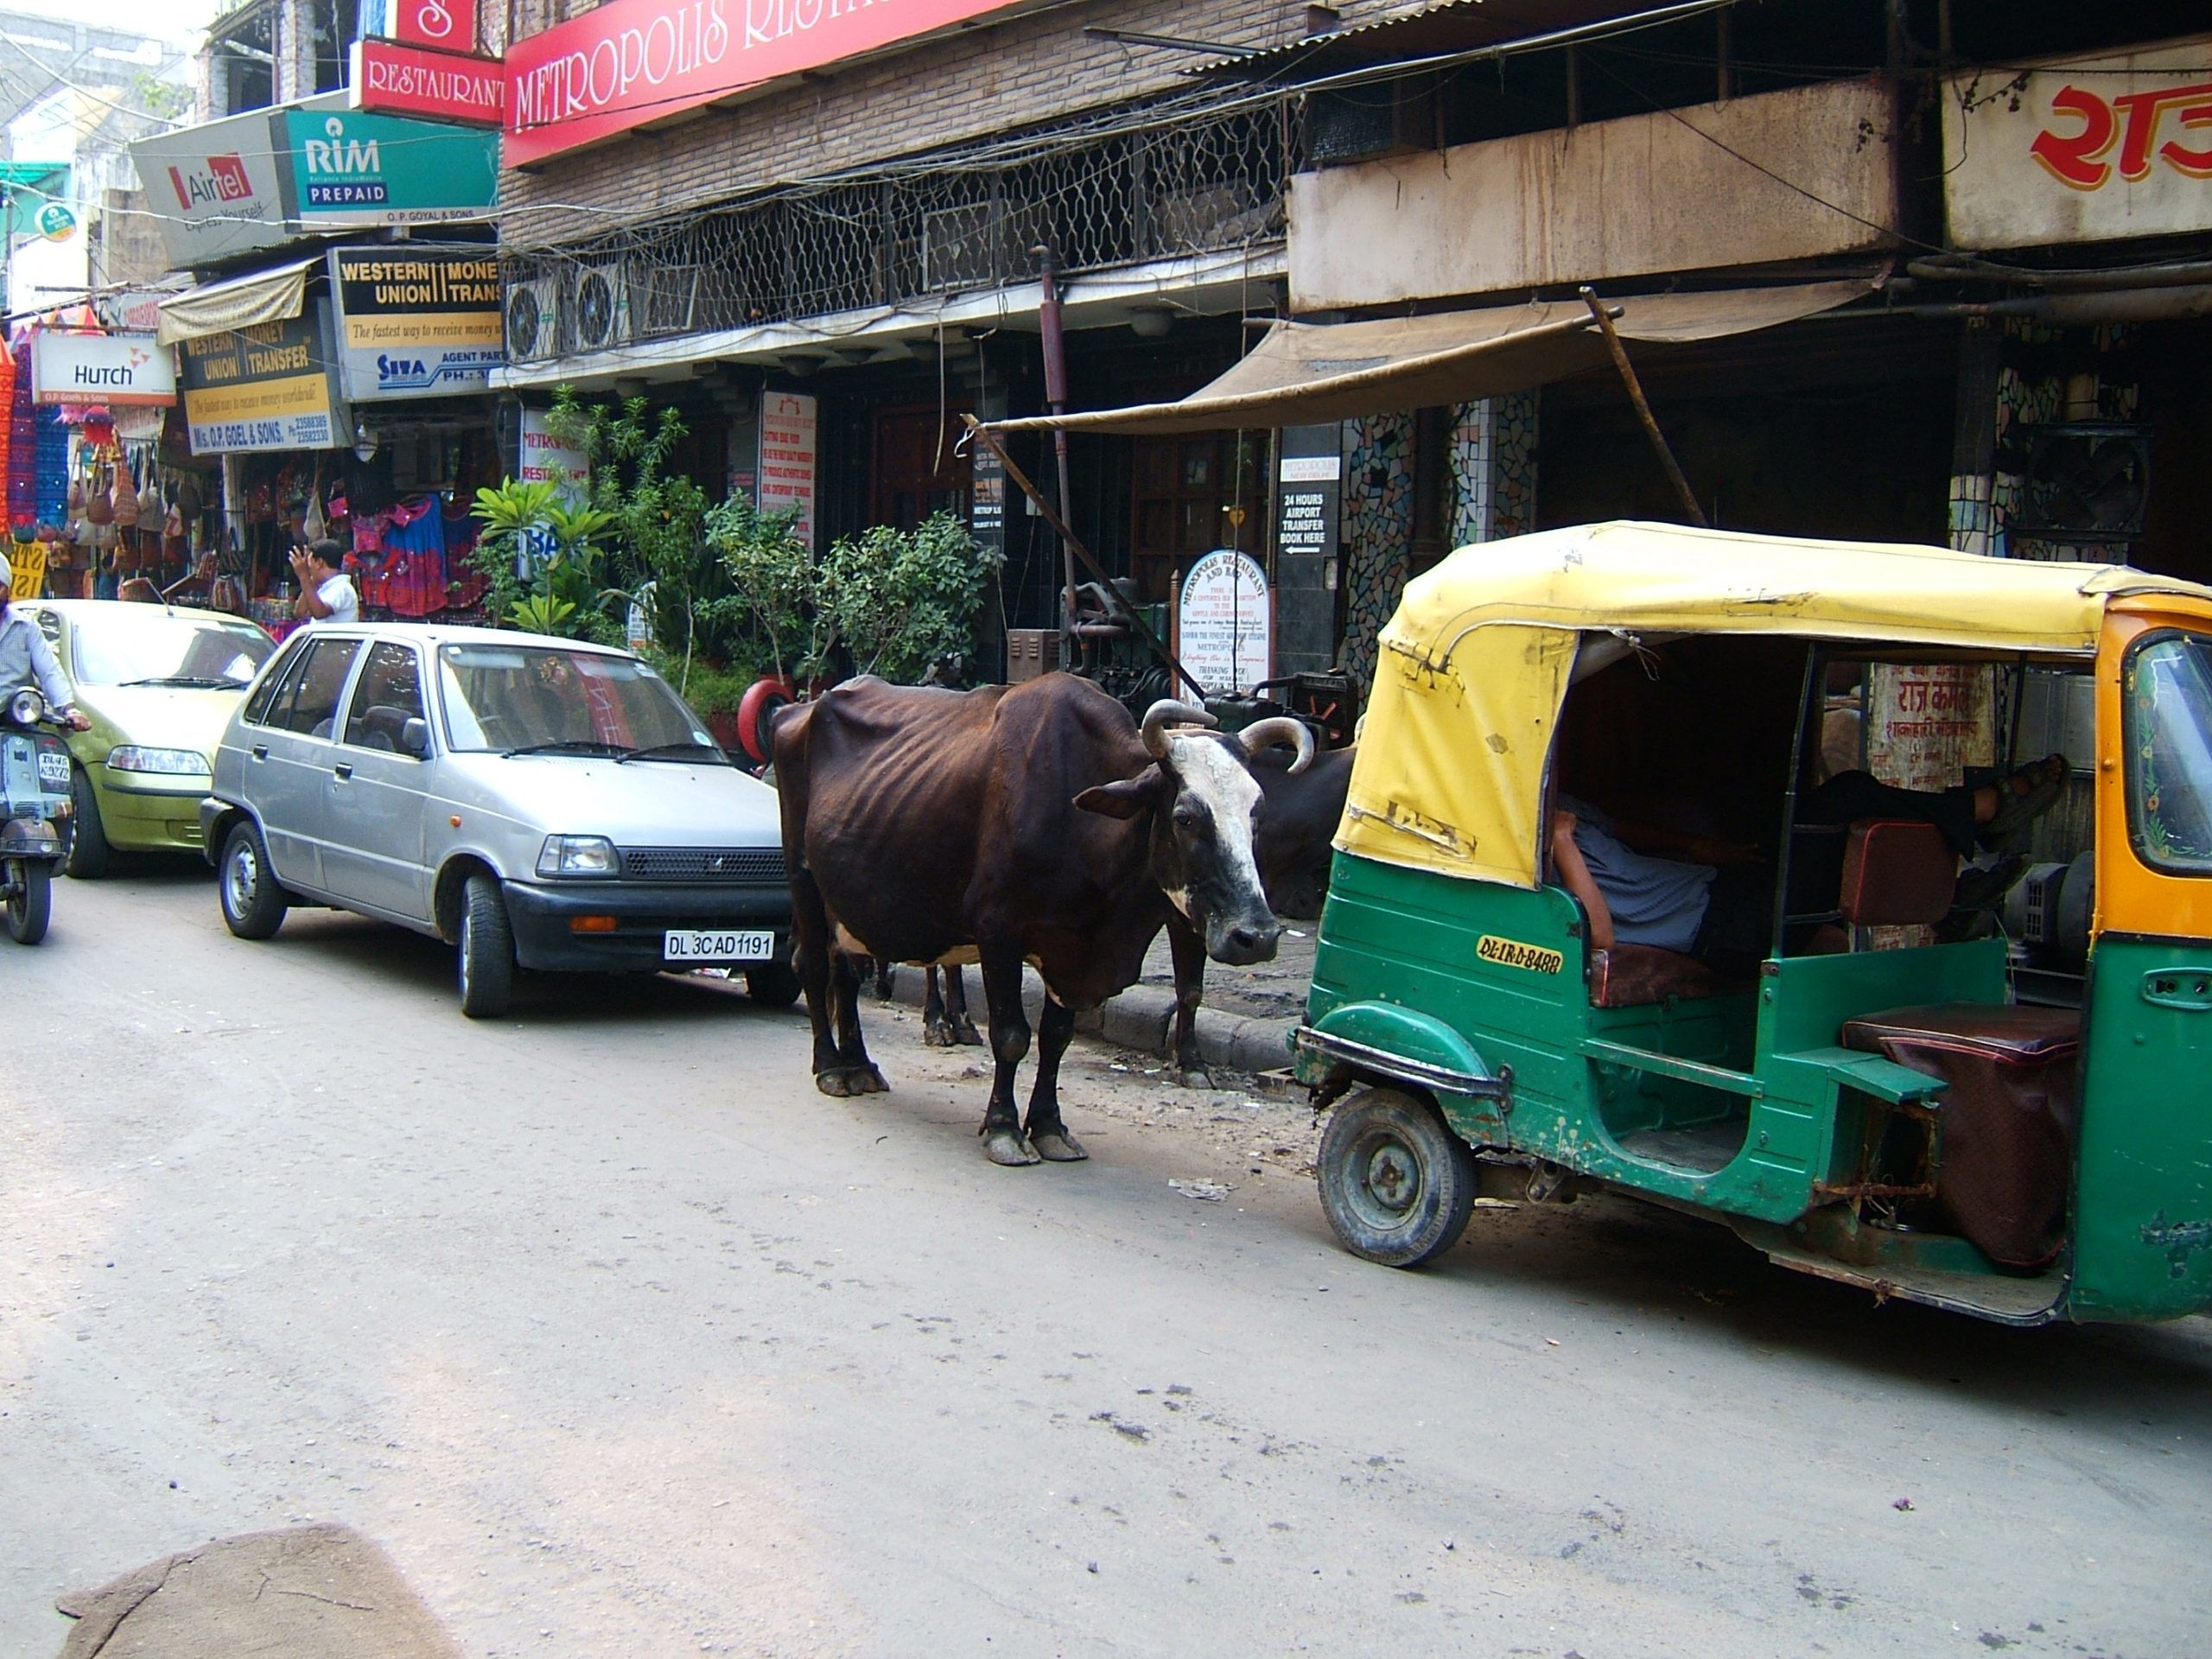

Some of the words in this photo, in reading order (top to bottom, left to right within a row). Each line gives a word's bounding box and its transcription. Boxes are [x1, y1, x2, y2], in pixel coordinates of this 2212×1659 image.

[515, 0, 728, 134] METROPOLIS
[369, 60, 505, 108] RESTAURANT
[311, 186, 385, 202] PREPAID
[409, 211, 437, 221] GOYAL
[341, 261, 430, 282] WESTERN
[375, 283, 432, 304] UNION
[245, 319, 285, 346] MONEY
[353, 324, 371, 340] The
[372, 323, 401, 340] fastest
[403, 325, 422, 340] way
[423, 324, 431, 337] to
[433, 321, 462, 336] receive
[465, 324, 493, 339] money
[203, 357, 238, 381] UNION
[248, 346, 309, 374] TRANSFER
[442, 352, 477, 363] AGENT
[226, 423, 249, 447] GOEL
[249, 423, 257, 445] &
[1284, 495, 1294, 506] 24
[1296, 493, 1324, 505] HOURS
[1286, 507, 1321, 518] AIRPORT
[1282, 519, 1324, 531] TRANSFER
[1280, 533, 1303, 544] BOOK
[1303, 532, 1325, 543] HERE
[1206, 566, 1223, 583] AND
